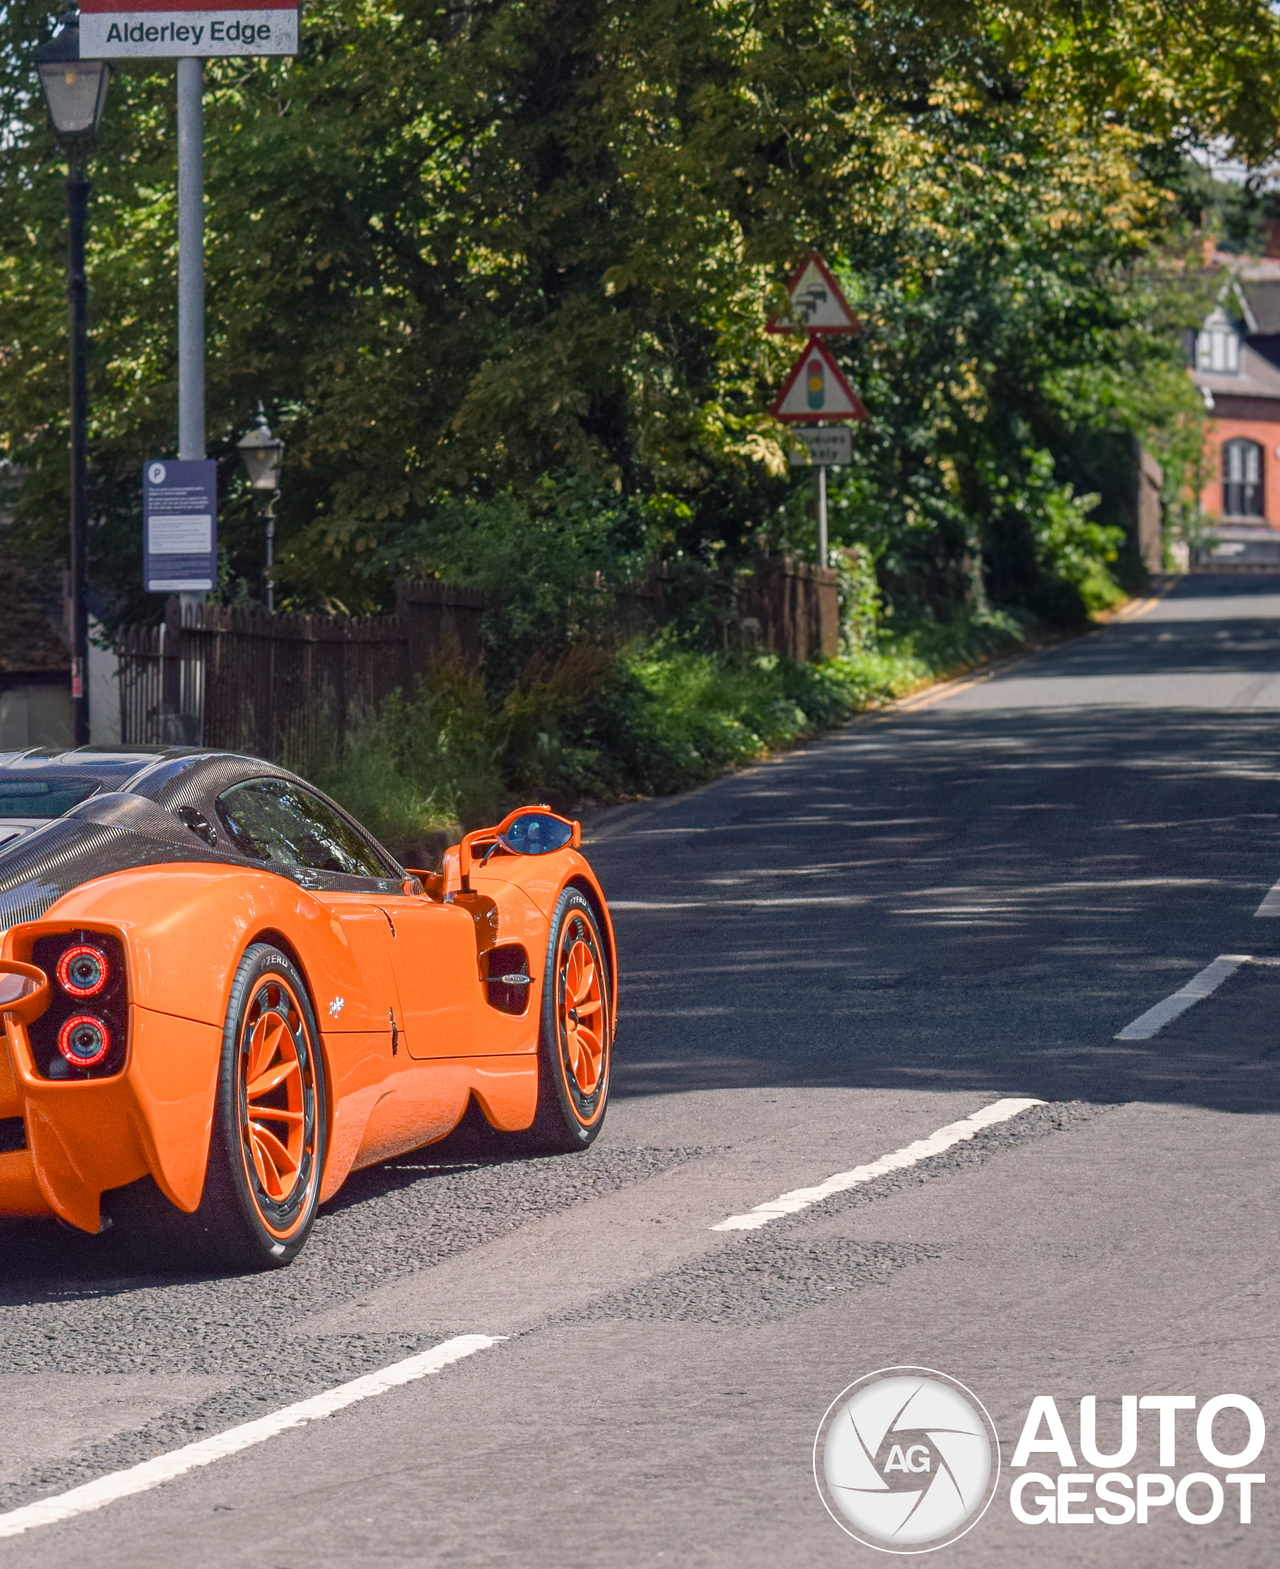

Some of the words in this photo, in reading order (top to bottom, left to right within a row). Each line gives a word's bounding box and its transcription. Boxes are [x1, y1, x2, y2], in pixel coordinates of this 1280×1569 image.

[106, 21, 204, 45] Alderley
[210, 20, 271, 44] Edge
[154, 468, 161, 479] P
